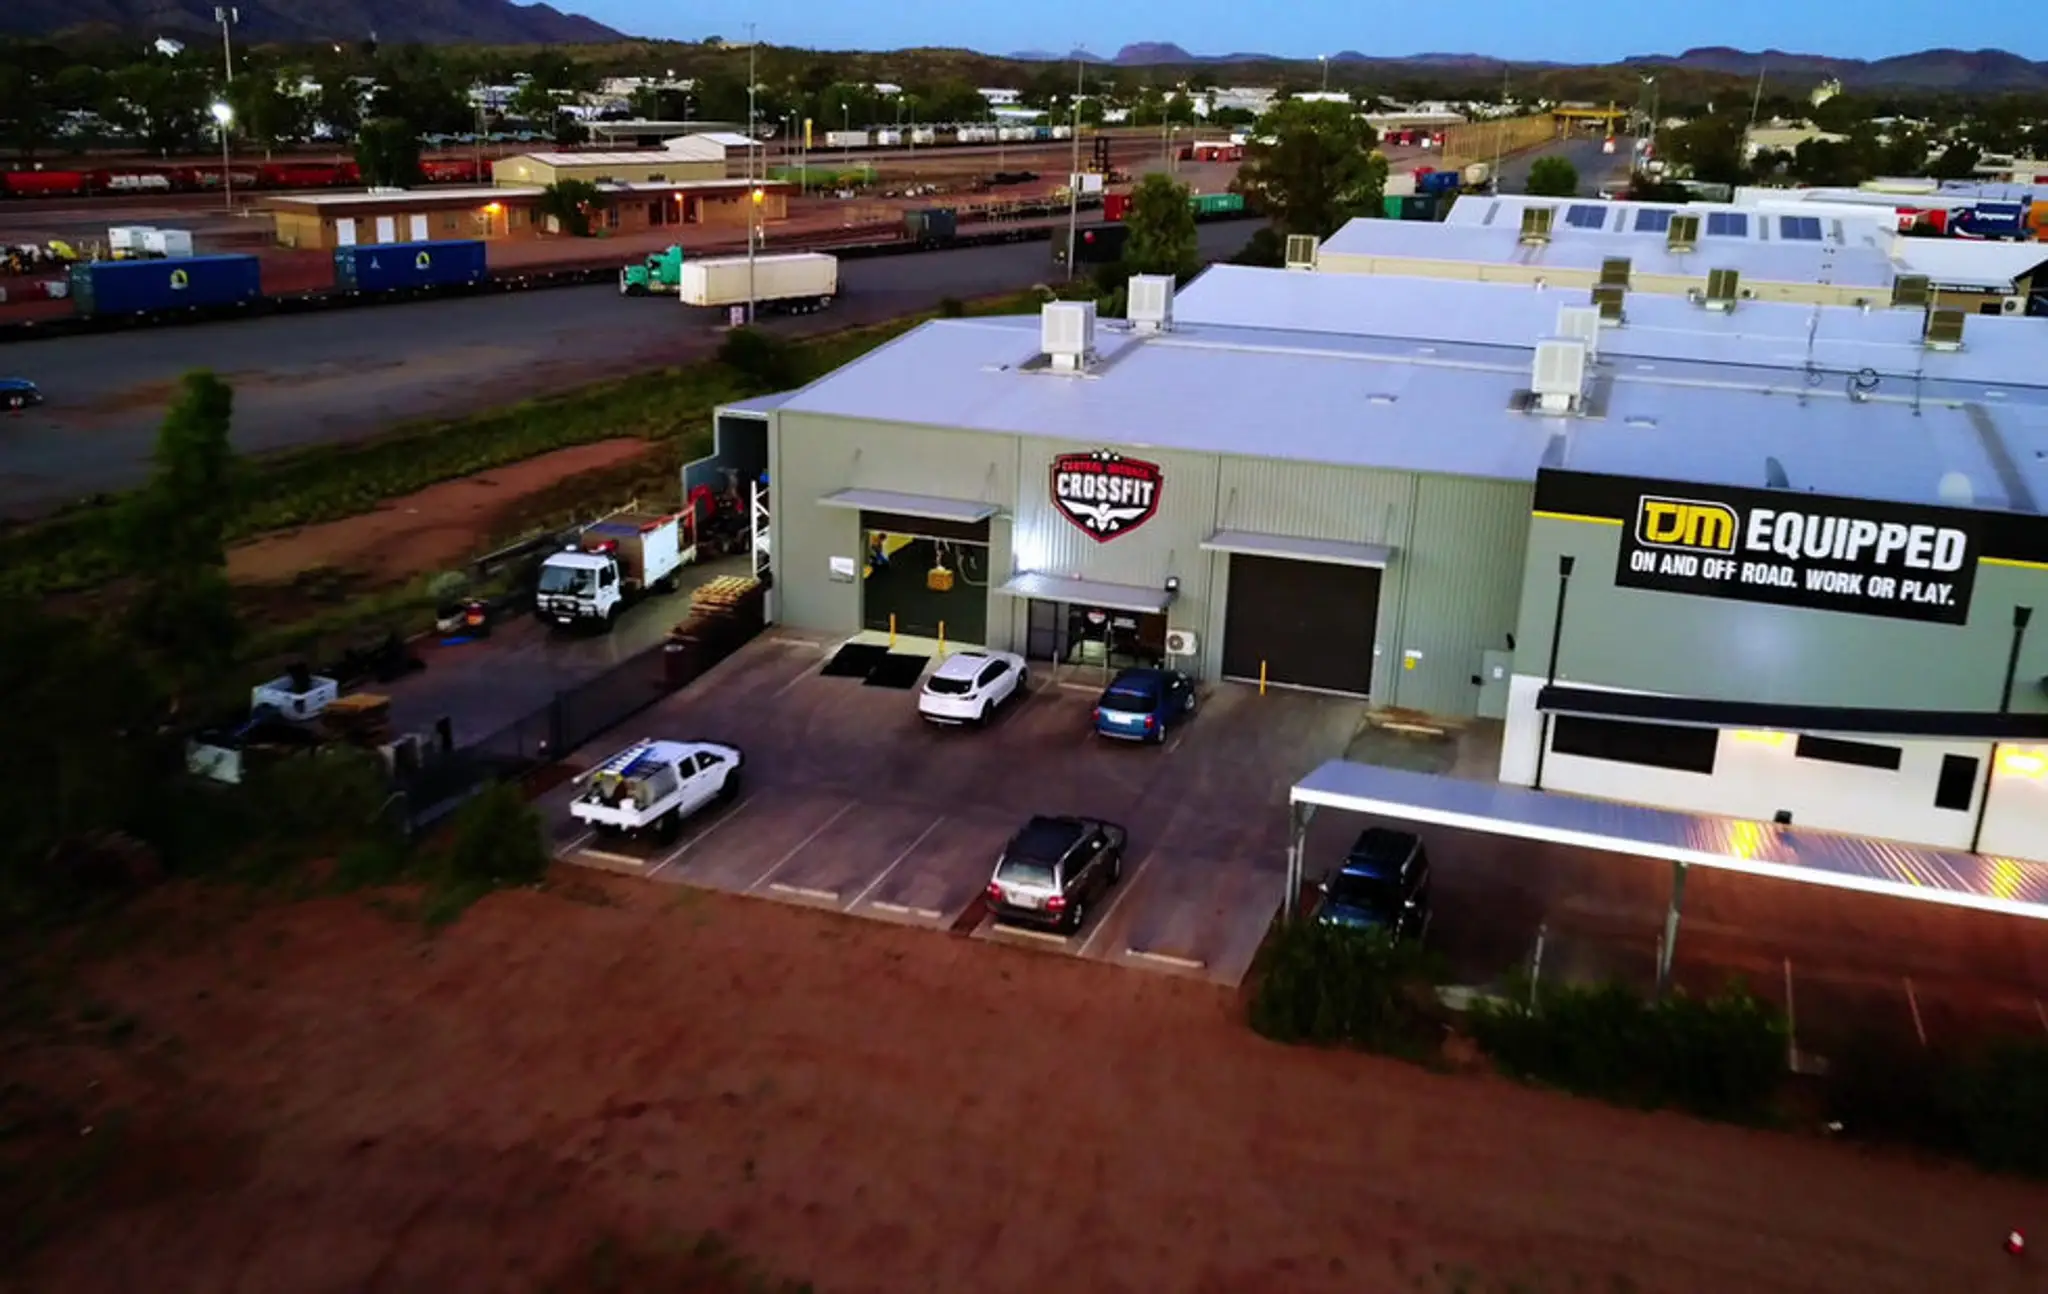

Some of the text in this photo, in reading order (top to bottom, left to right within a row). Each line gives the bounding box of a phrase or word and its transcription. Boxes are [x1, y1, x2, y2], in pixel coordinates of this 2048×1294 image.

[1057, 473, 1154, 505] CROSSFIT
[1644, 501, 1967, 572] TJM EQUIPPED
[1630, 550, 1955, 605] ON AND OFF ROAD. WORK OR PLAY.
